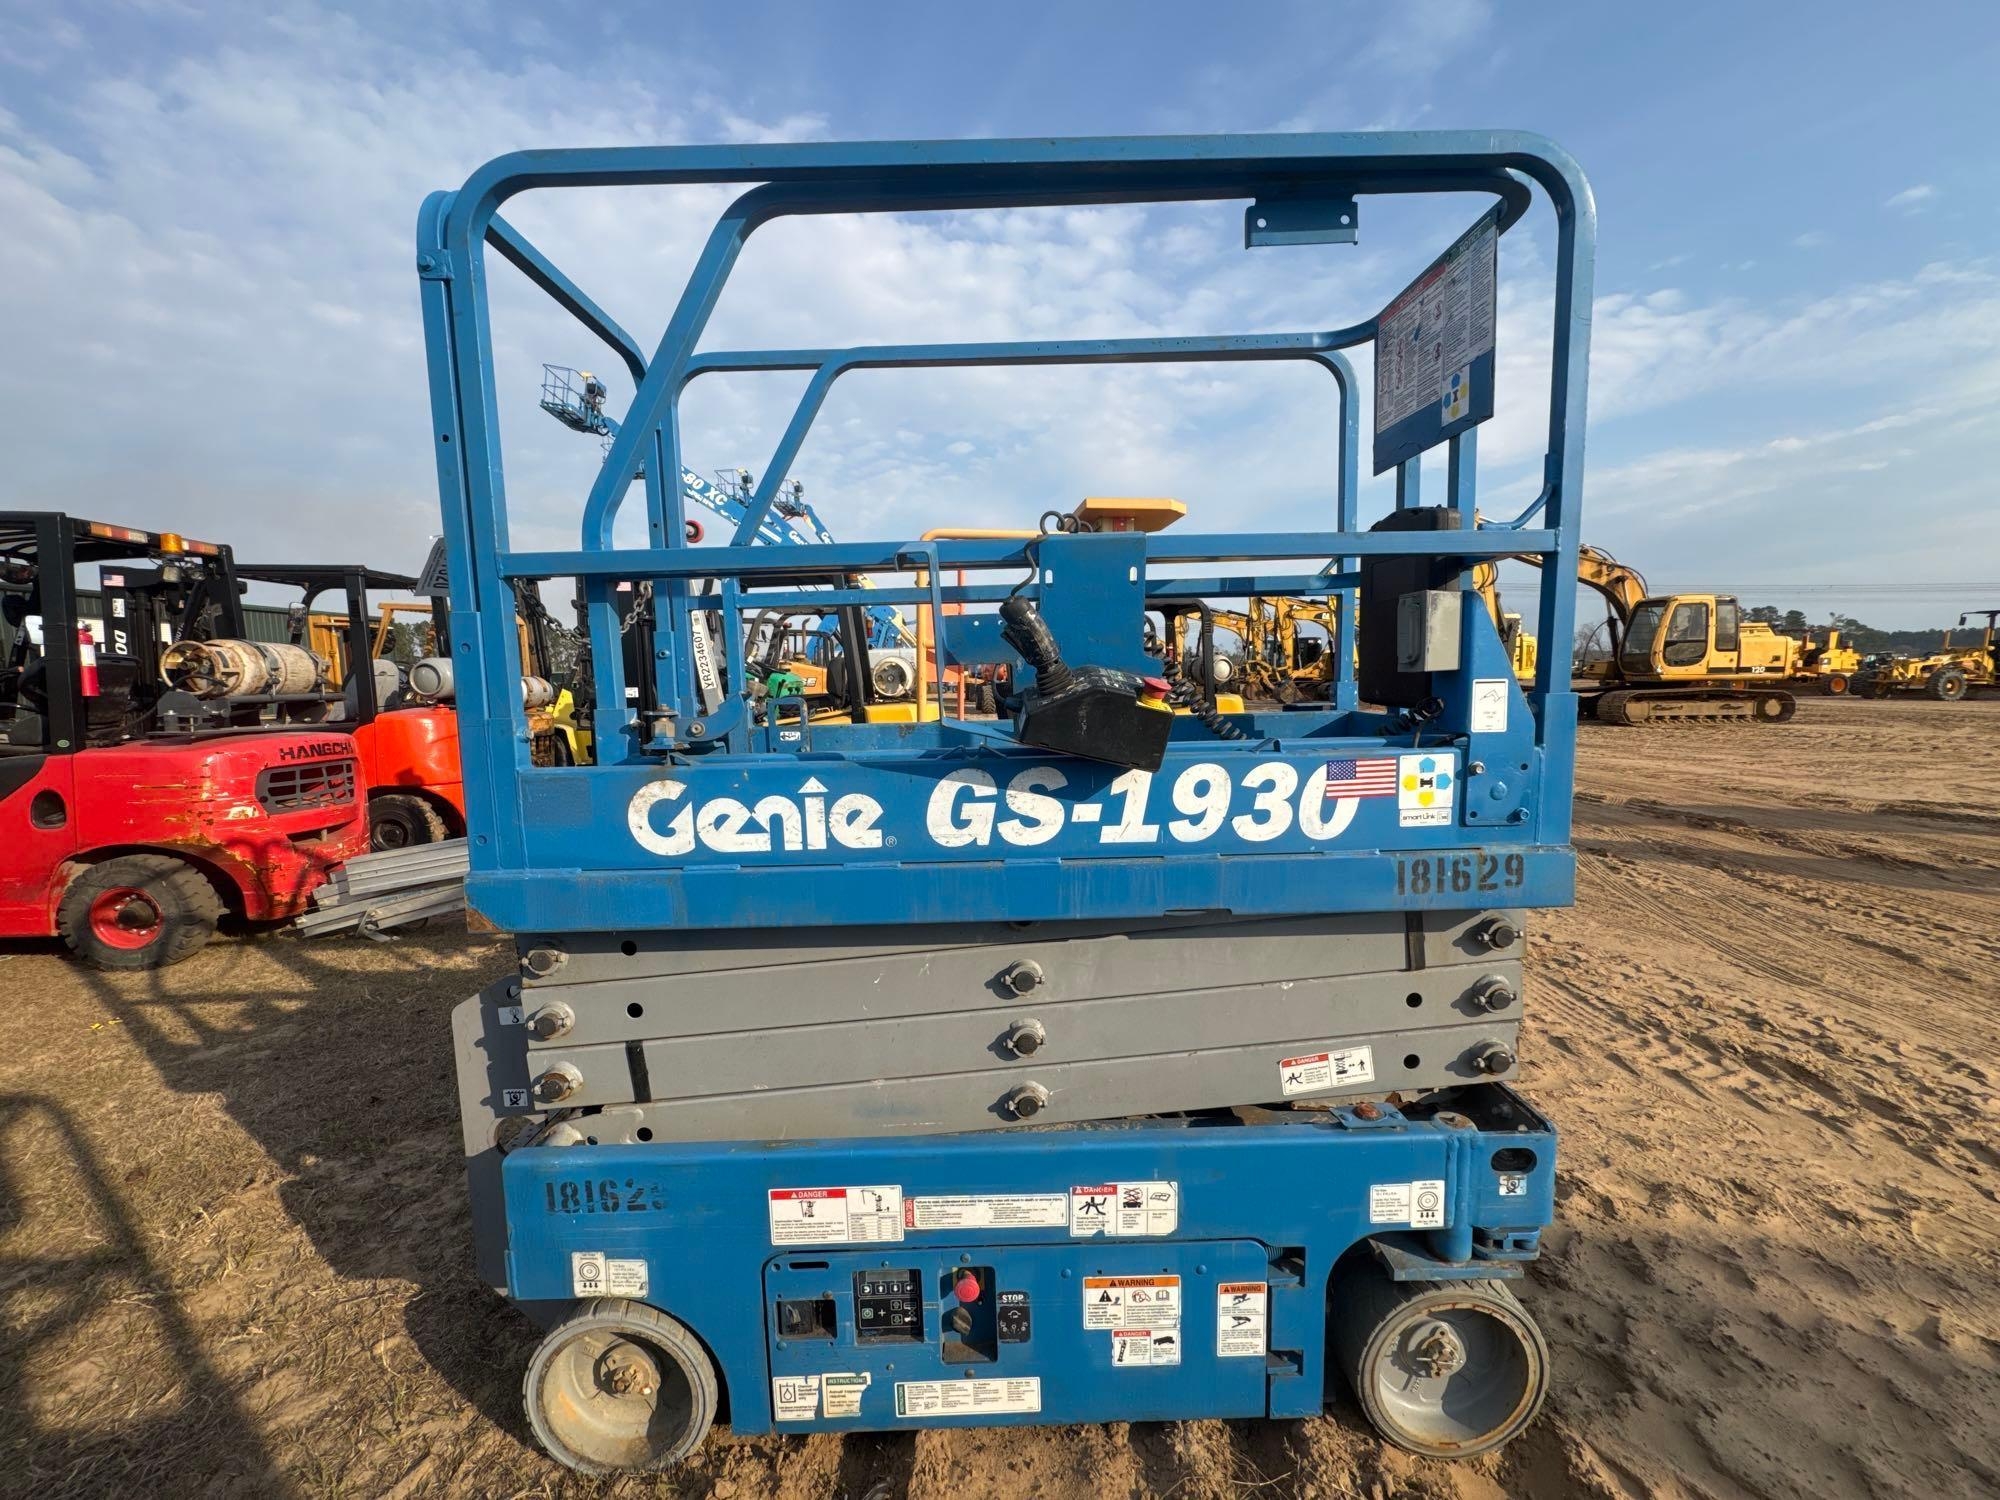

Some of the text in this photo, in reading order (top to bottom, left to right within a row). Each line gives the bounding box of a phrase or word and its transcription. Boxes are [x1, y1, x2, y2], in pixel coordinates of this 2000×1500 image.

[704, 486, 728, 506] XC
[627, 761, 1361, 856] Genie GS-1930
[1397, 853, 1524, 896] 181629
[798, 1190, 828, 1198] DANGER
[1117, 1279, 1154, 1287] WARNING
[1002, 1294, 1024, 1303] STOP
